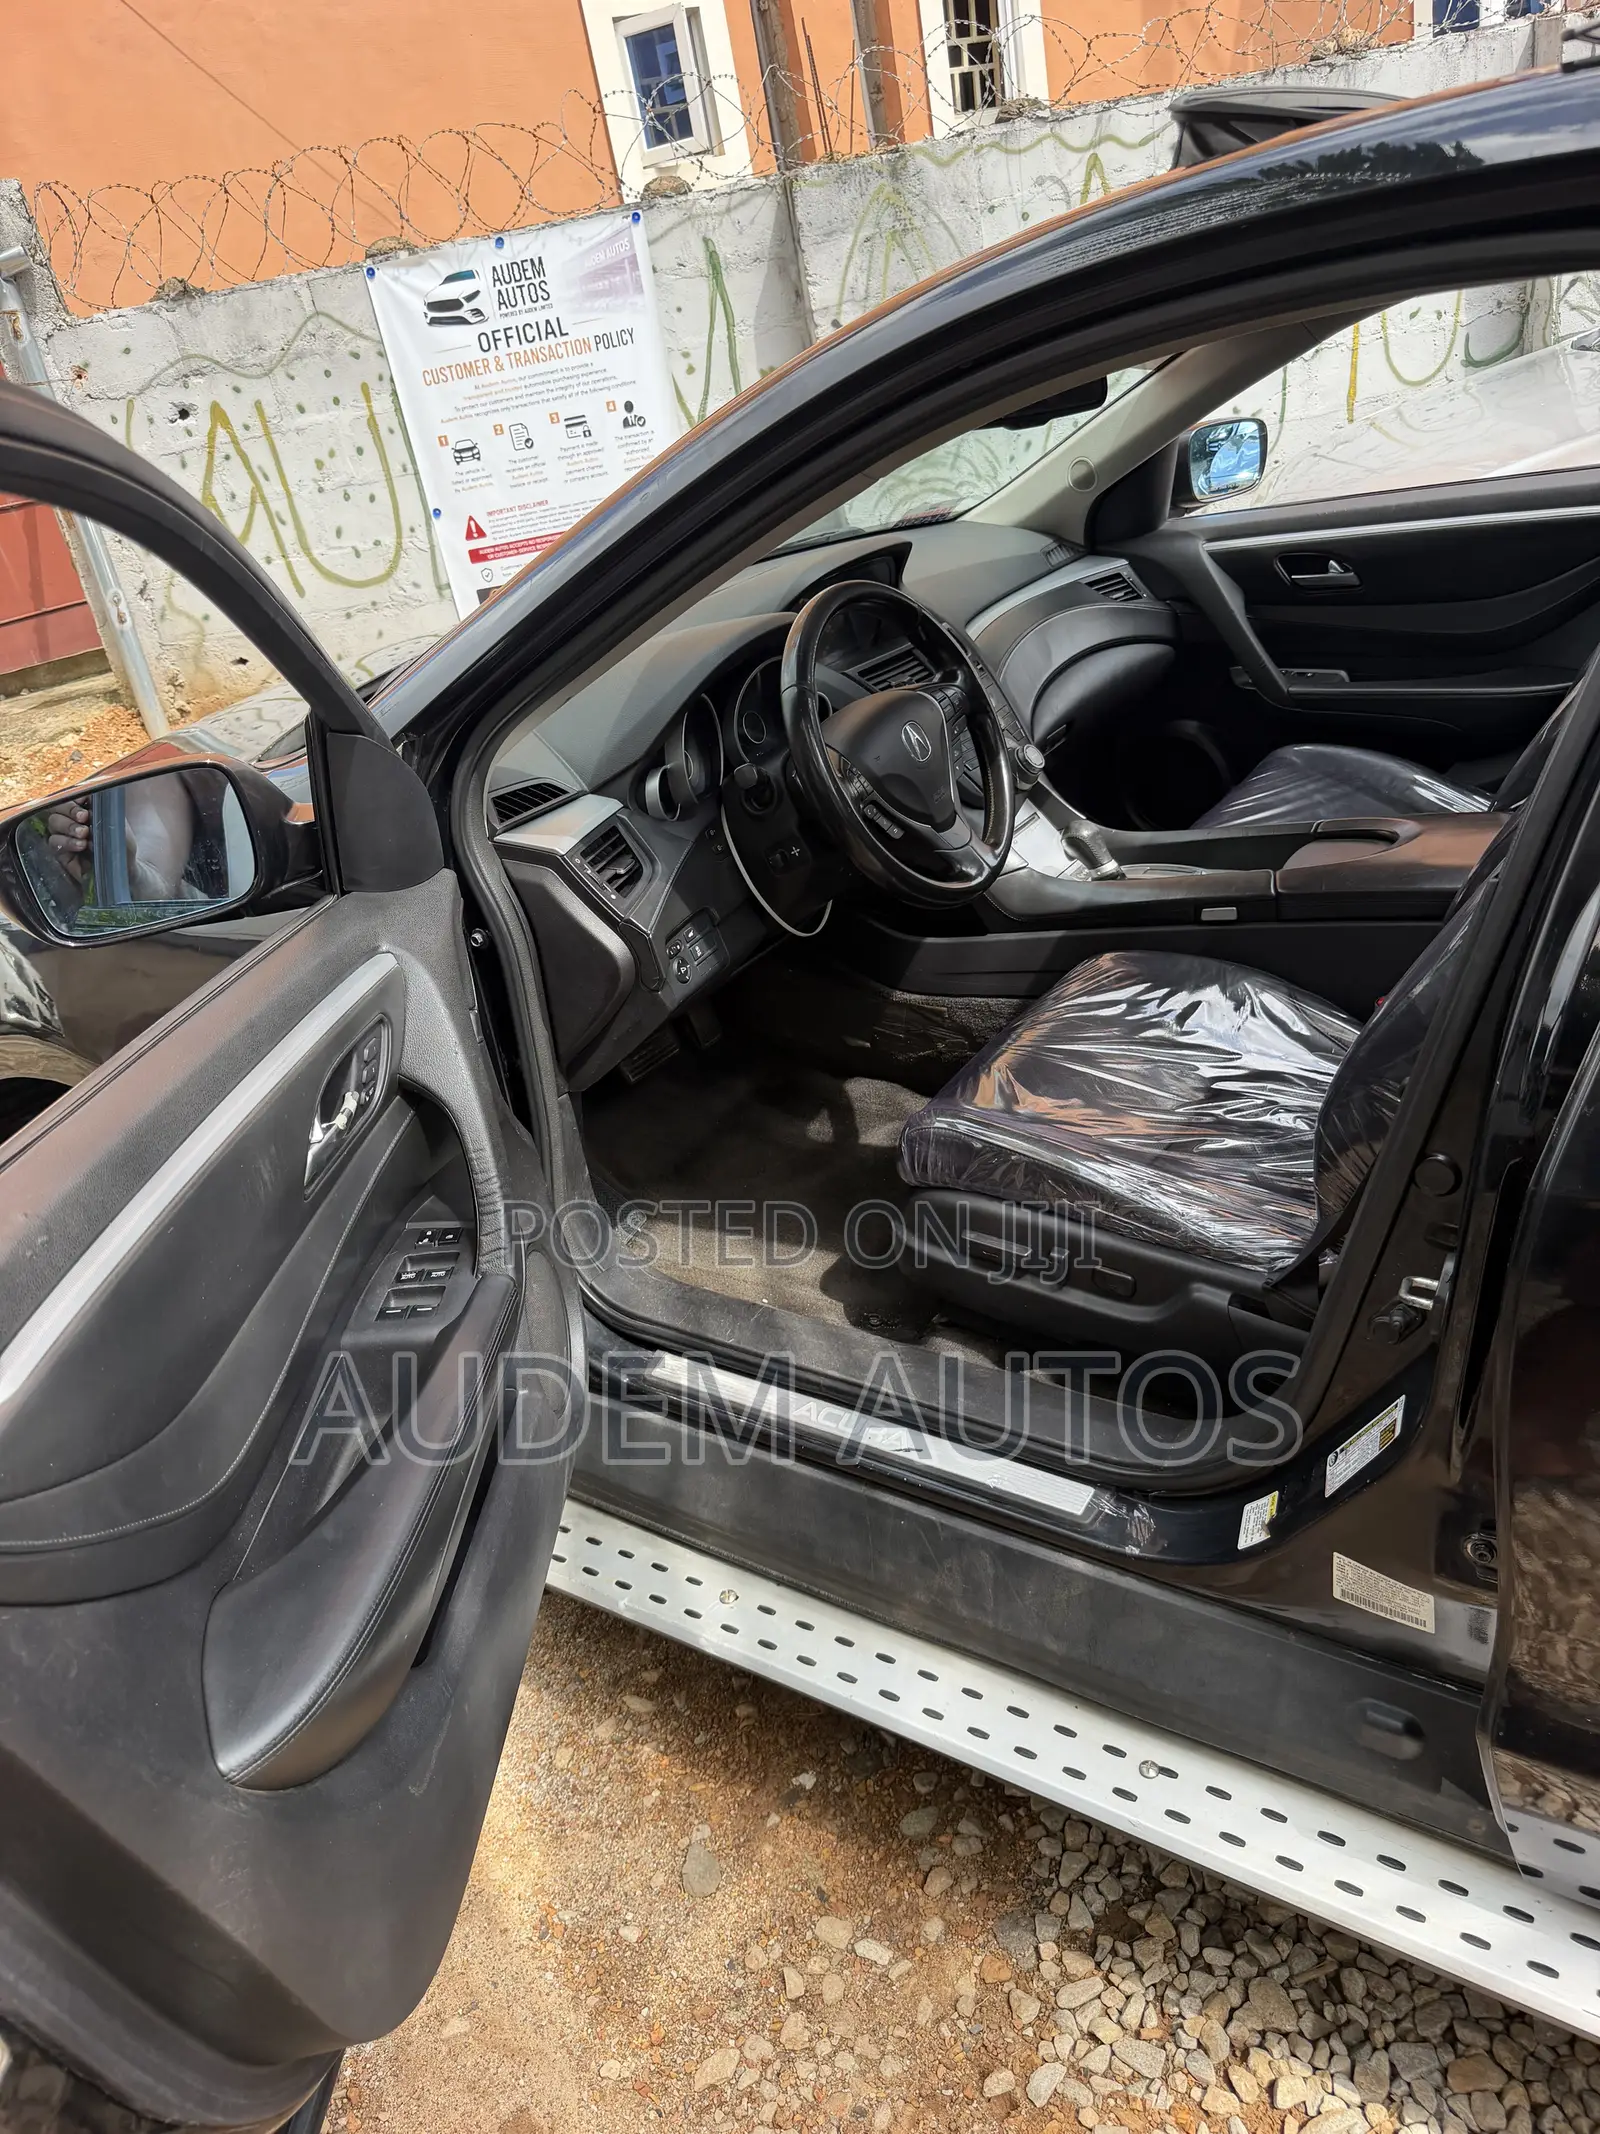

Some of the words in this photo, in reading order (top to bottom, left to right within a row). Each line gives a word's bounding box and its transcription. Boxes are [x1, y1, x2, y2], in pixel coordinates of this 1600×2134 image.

[606, 237, 631, 259] AUTOS
[491, 256, 545, 287] AUDEM
[496, 280, 550, 311] AUTOS
[538, 303, 553, 311] LIMITED
[478, 316, 569, 353] OFFICIAL
[422, 357, 492, 386] CUSTOMER
[494, 355, 505, 372] &
[507, 337, 593, 369] TRANSACTION
[594, 327, 636, 352] POLICY
[527, 368, 559, 380] commitment
[571, 362, 590, 371] provide
[524, 379, 552, 390] automobile
[552, 373, 580, 384] purchasing
[461, 402, 479, 412] protect
[488, 395, 514, 406] customers
[514, 393, 524, 401] and
[524, 389, 545, 399] maintain
[555, 383, 575, 392] integrity
[474, 407, 500, 419] recognizes
[500, 405, 511, 413] only
[512, 399, 541, 411] transactions
[541, 397, 551, 405] that
[551, 393, 568, 403] satisfy
[580, 389, 589, 397] the
[589, 385, 611, 395] following
[609, 402, 615, 411] 4
[552, 414, 558, 423] 3
[495, 425, 503, 434] 2
[440, 437, 446, 446] 1
[487, 506, 518, 517] IMPORTANT
[518, 499, 549, 511] DISCLAIMER
[791, 1401, 910, 1449] ACURA
